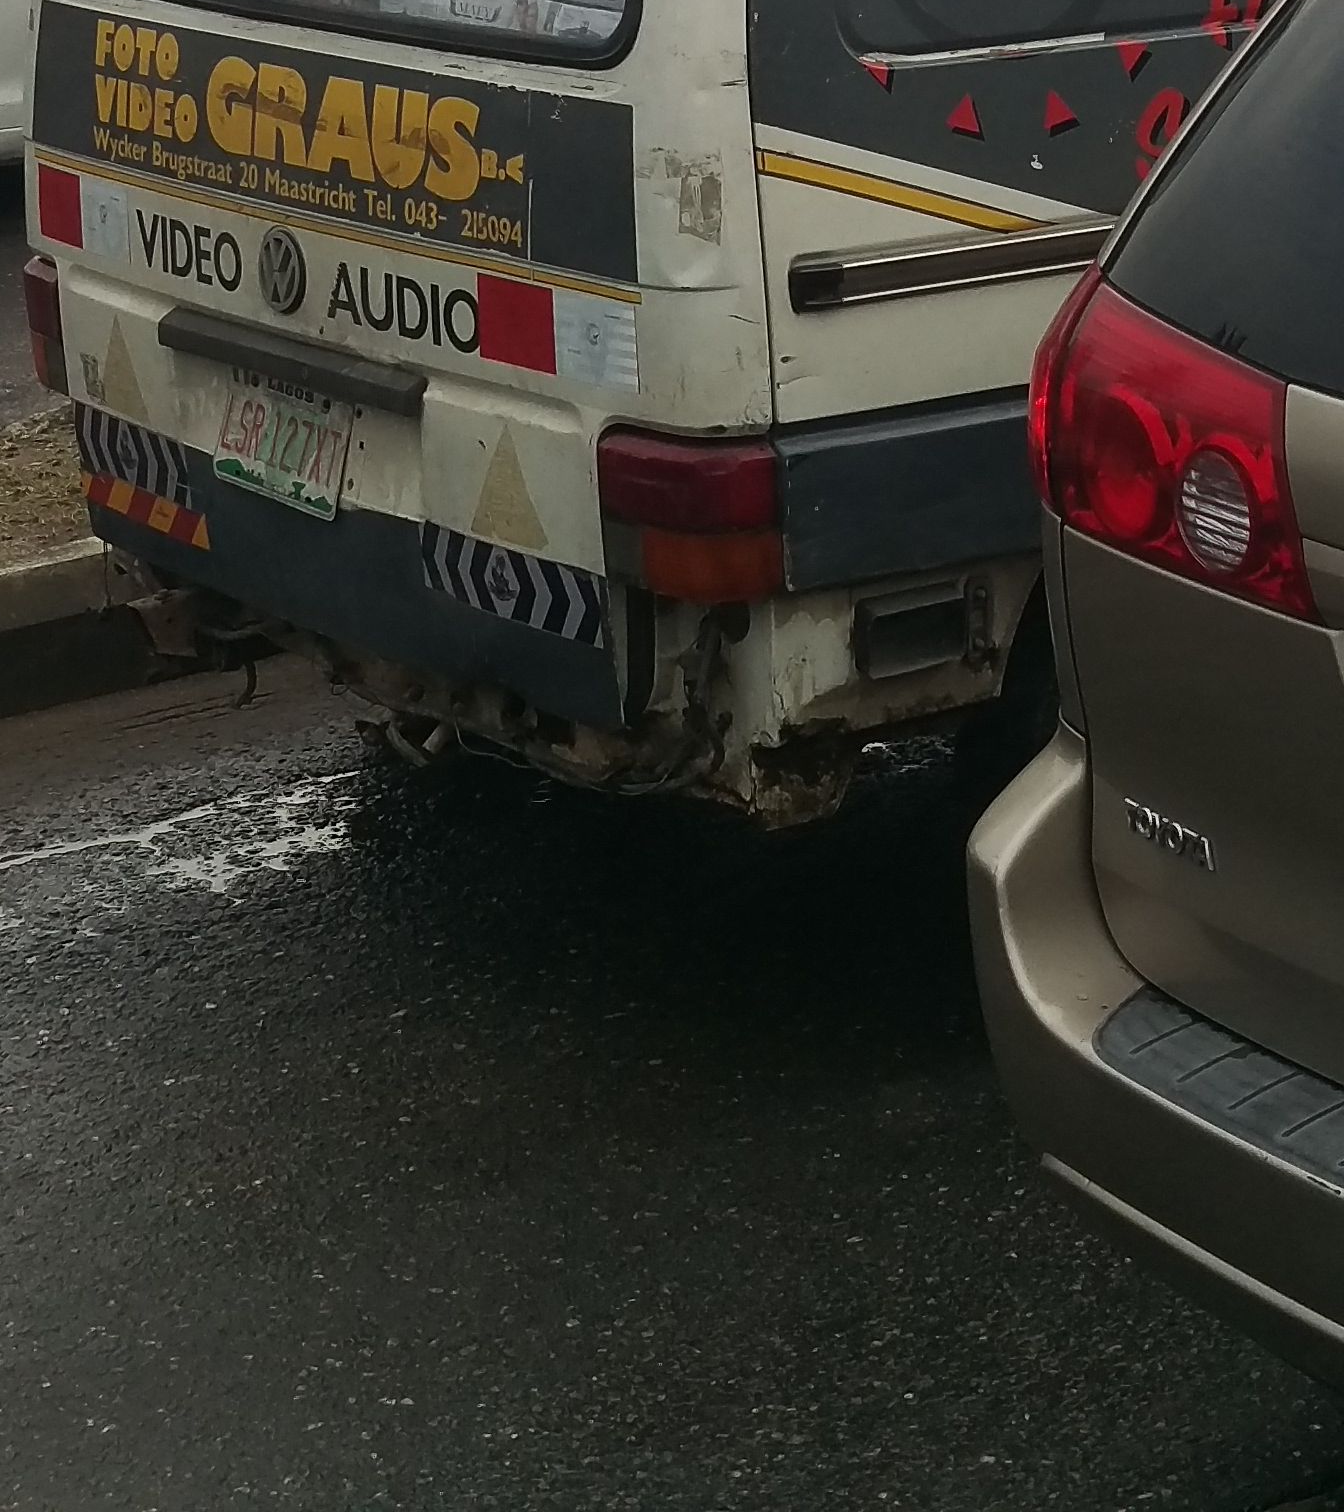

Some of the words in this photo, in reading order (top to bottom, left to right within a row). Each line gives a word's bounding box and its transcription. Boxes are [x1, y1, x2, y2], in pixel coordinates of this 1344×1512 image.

[95, 18, 179, 81] FOTO
[95, 73, 198, 143] VIDEO
[207, 55, 480, 201] GRAUS
[93, 125, 147, 162] Wycker
[152, 140, 233, 186] Brugstraat
[239, 161, 258, 189] 20
[265, 167, 357, 213] Maastricht
[363, 189, 396, 222] Tel.
[136, 208, 243, 292] VIDEO
[327, 261, 480, 354] AUDIO
